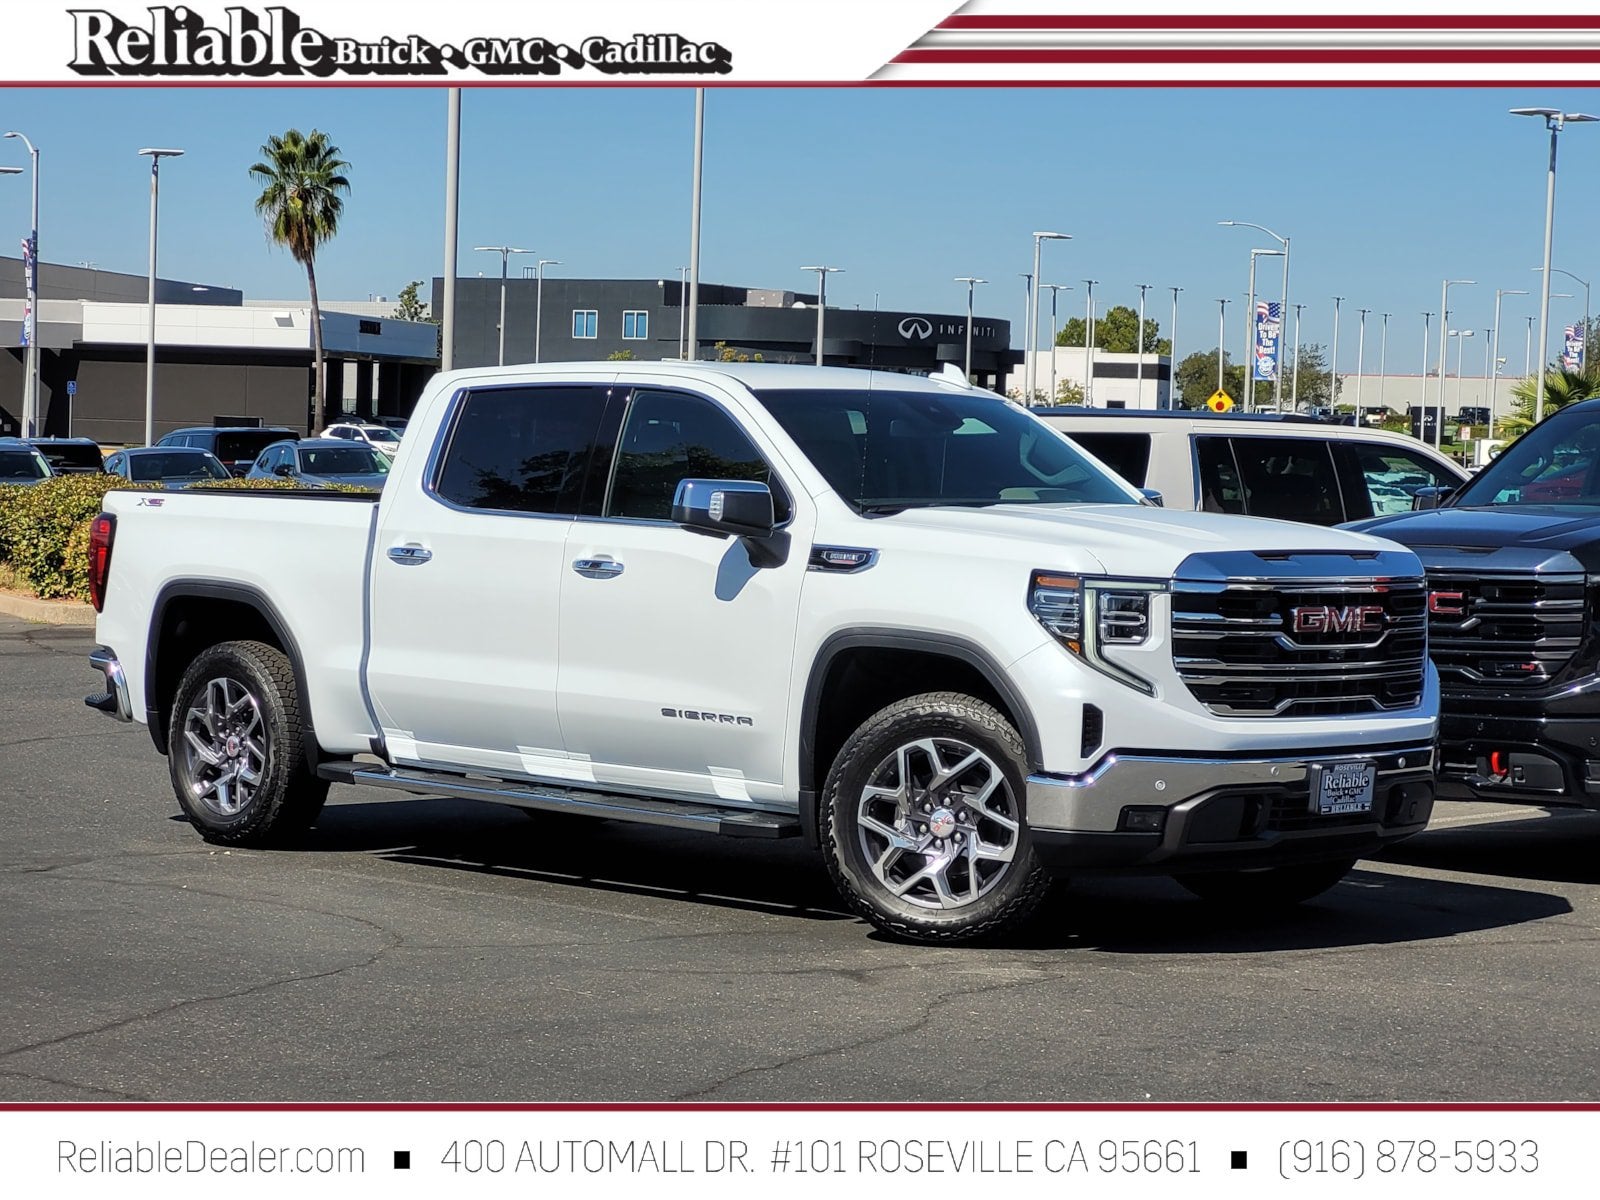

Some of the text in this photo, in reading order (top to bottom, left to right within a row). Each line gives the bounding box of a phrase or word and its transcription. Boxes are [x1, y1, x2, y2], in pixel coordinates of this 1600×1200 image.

[940, 324, 995, 337] INFNITI
[1293, 606, 1383, 632] GMC
[661, 708, 753, 726] SIERRA
[1334, 763, 1366, 771] ROSEVILLE
[1325, 773, 1369, 789] Reliable
[1332, 795, 1356, 803] Cadillac
[1331, 803, 1362, 813] RELIABLE
